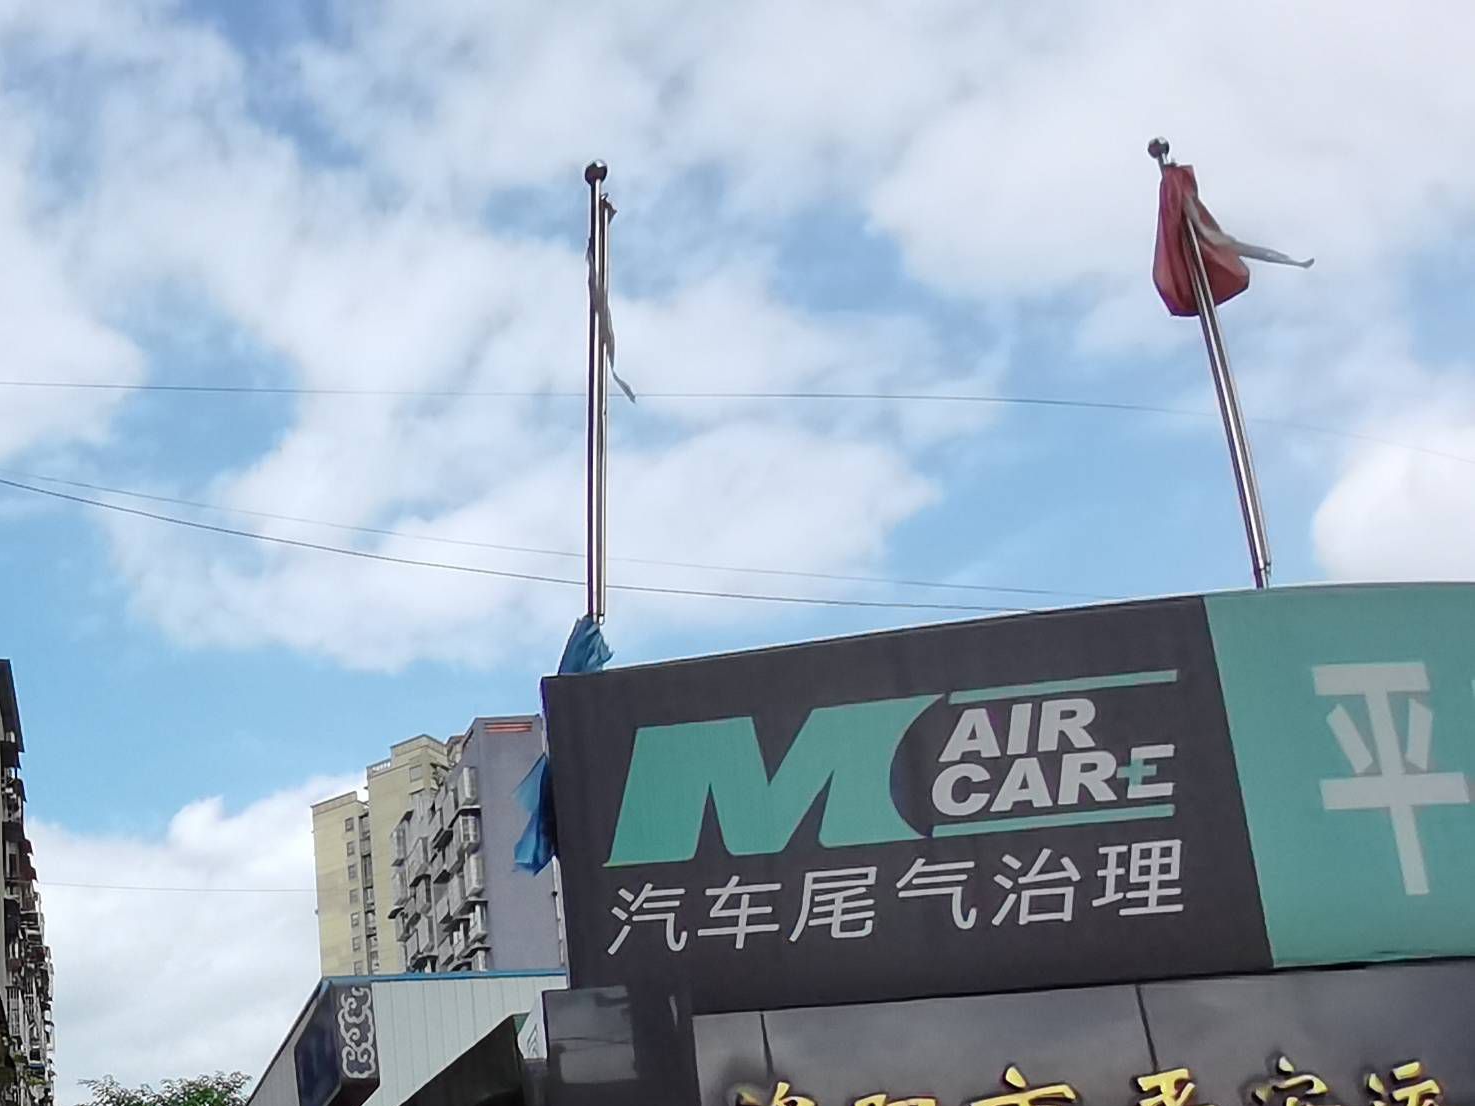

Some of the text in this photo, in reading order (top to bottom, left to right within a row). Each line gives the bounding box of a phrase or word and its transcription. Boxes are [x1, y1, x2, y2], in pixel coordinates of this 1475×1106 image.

[938, 698, 1098, 762] AIR
[931, 744, 1176, 817] CARE
[1311, 661, 1470, 896] 平
[607, 838, 1184, 955] 汽车尾气治理
